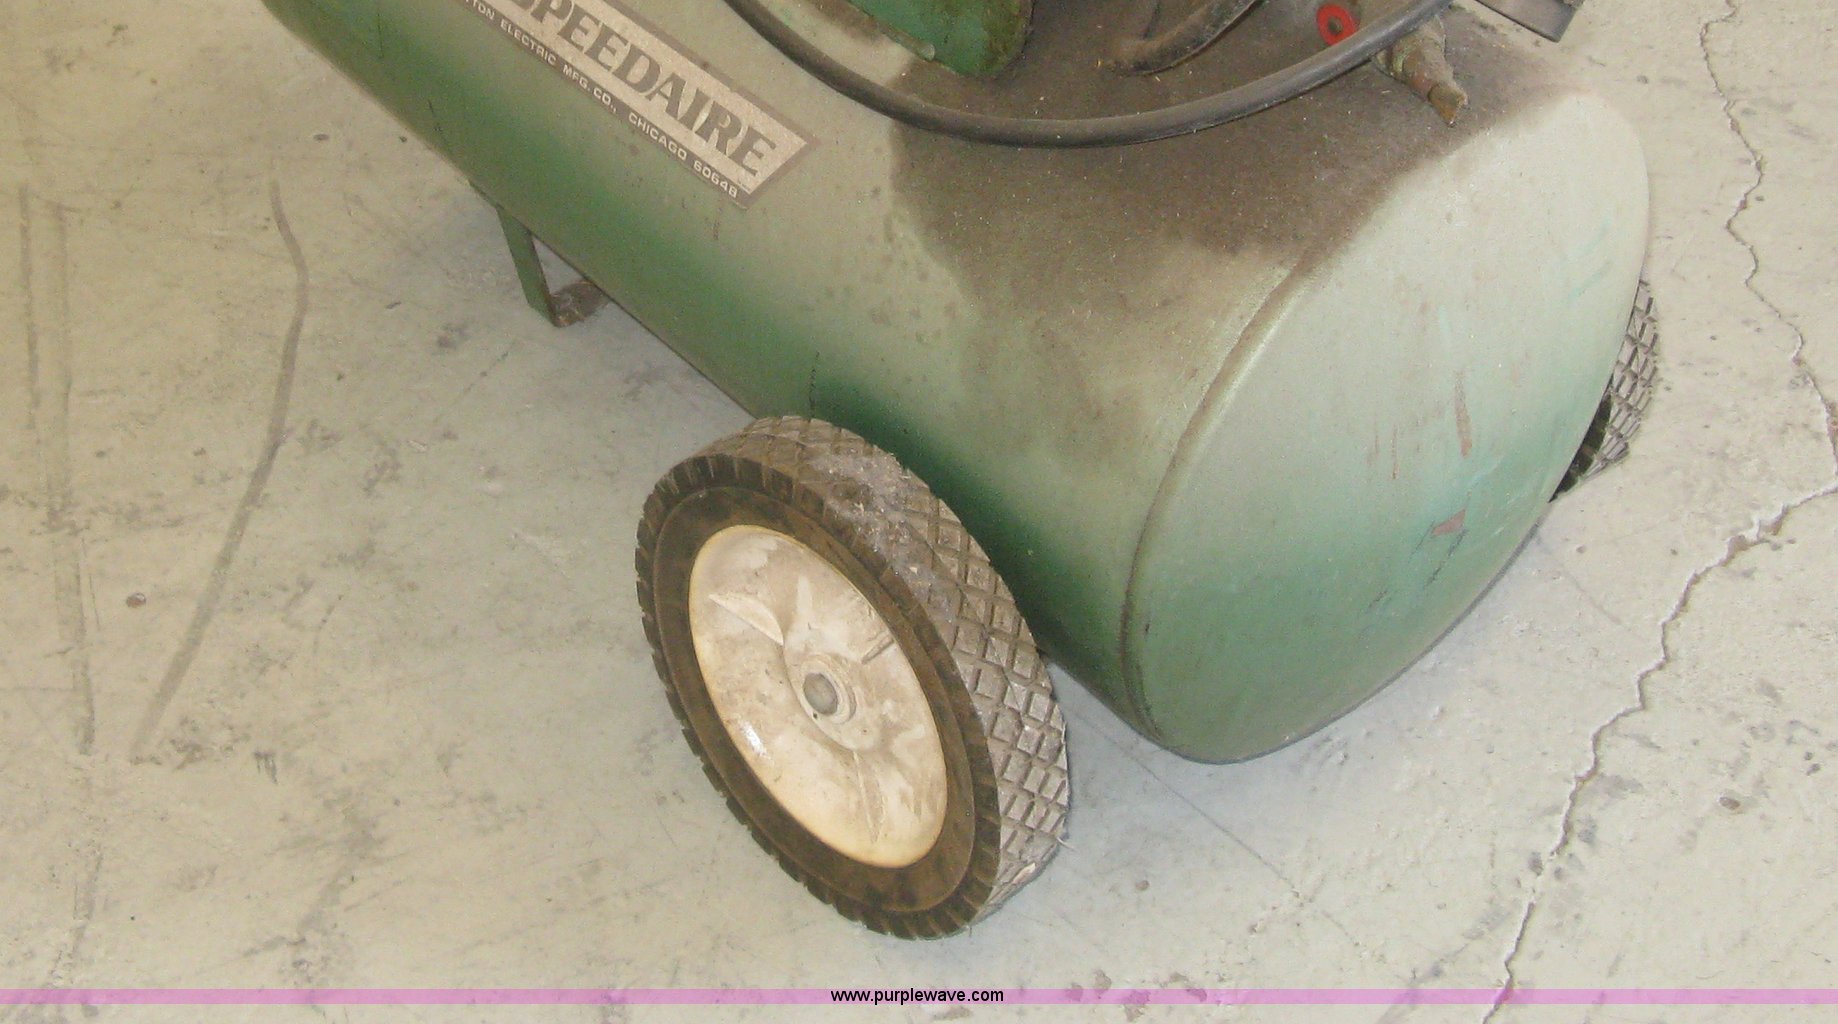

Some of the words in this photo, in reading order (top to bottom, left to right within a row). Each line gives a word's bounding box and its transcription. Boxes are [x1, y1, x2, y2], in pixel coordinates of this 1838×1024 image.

[500, 20, 557, 65] ELECTRIC
[628, 112, 687, 161] CHICAGO
[693, 160, 738, 198] 60648
